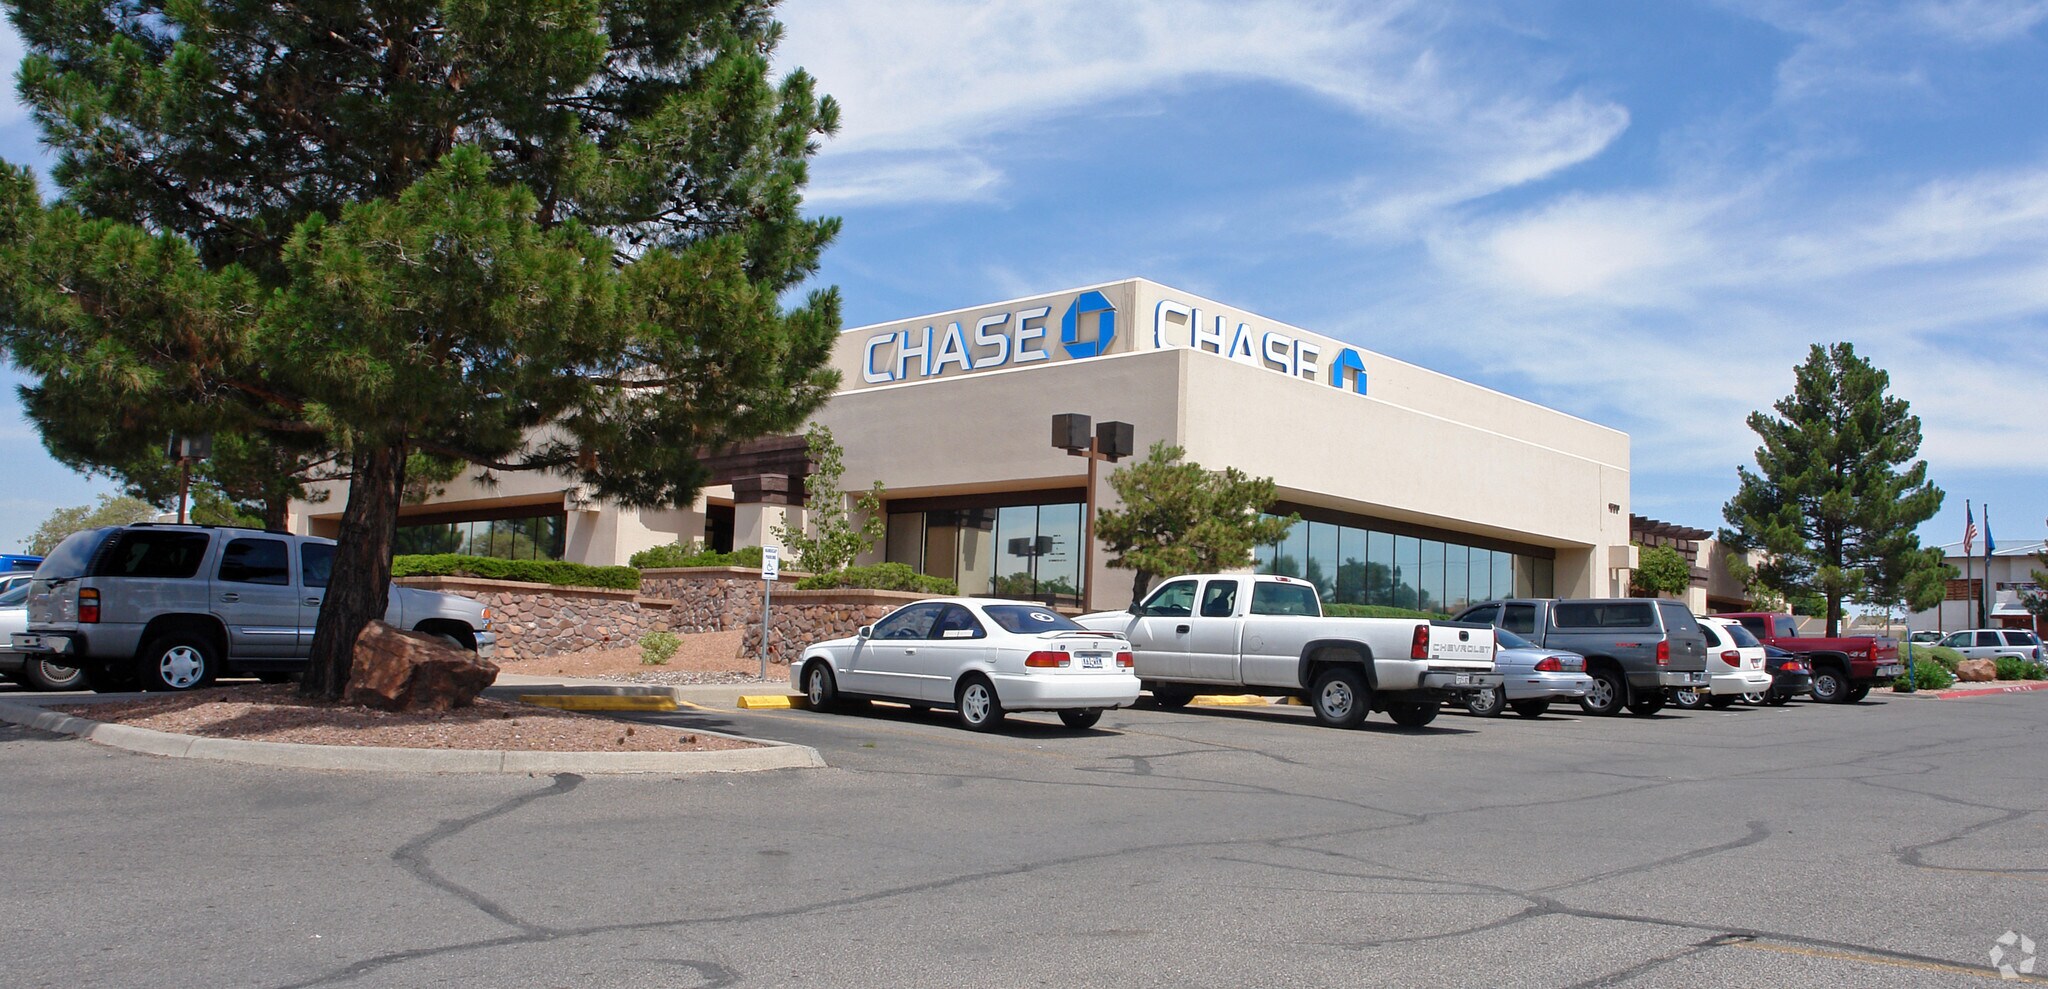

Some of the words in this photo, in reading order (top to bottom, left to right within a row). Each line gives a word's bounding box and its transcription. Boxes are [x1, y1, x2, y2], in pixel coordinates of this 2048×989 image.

[863, 306, 1051, 384] CHASE
[1154, 299, 1321, 381] CHASE
[1433, 643, 1491, 653] CHEVROLET
